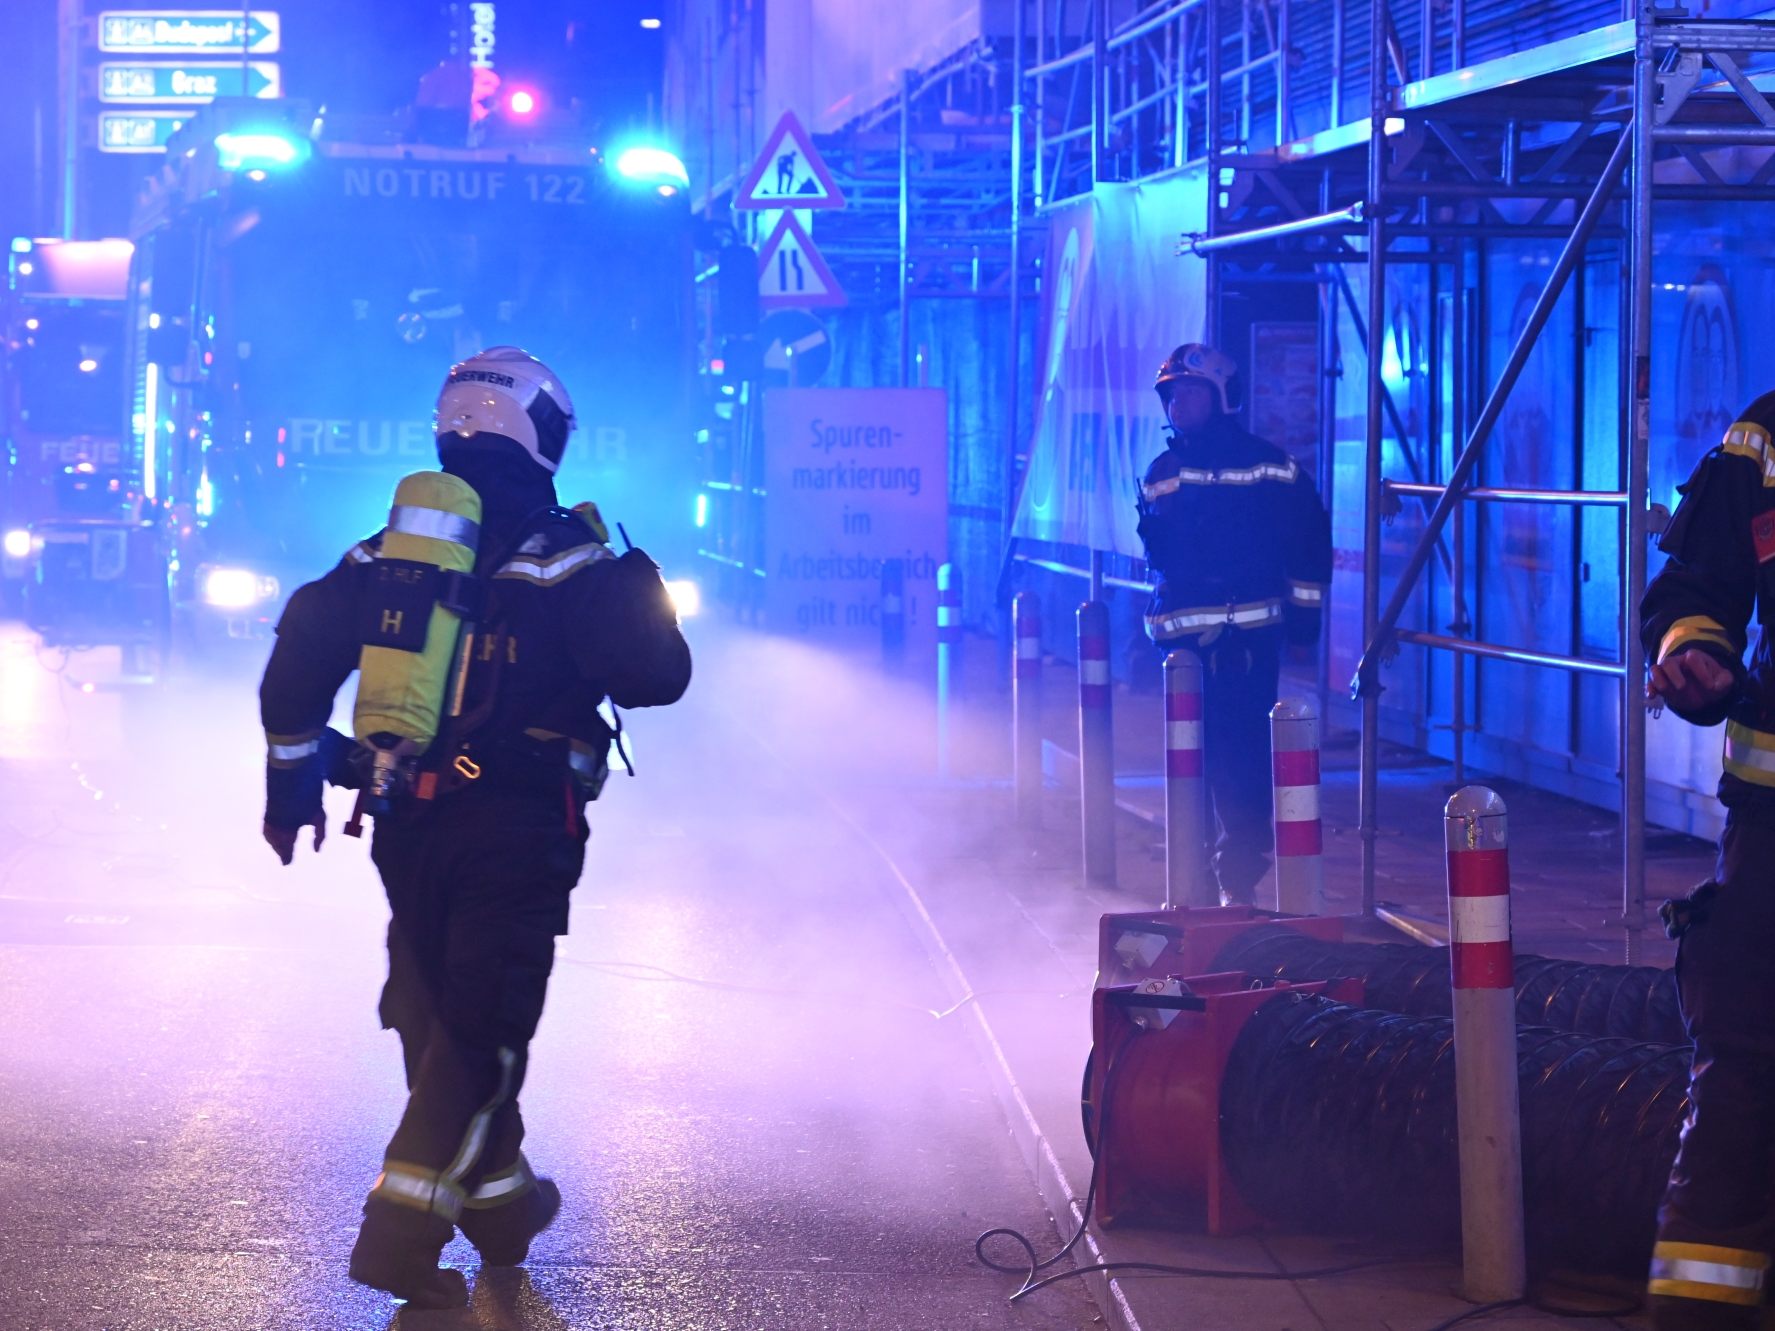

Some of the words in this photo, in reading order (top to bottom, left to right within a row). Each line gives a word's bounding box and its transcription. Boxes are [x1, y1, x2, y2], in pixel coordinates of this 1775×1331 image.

[171, 70, 217, 94] Graz
[343, 168, 505, 200] NOTRUF
[525, 174, 585, 205] 122
[810, 419, 903, 454] Spuren-
[792, 459, 921, 496] markierung
[842, 505, 871, 535] im
[778, 549, 936, 580] Arbeitsbeich
[380, 609, 404, 635] H
[797, 597, 837, 632] gilt
[846, 596, 918, 627] nic!
